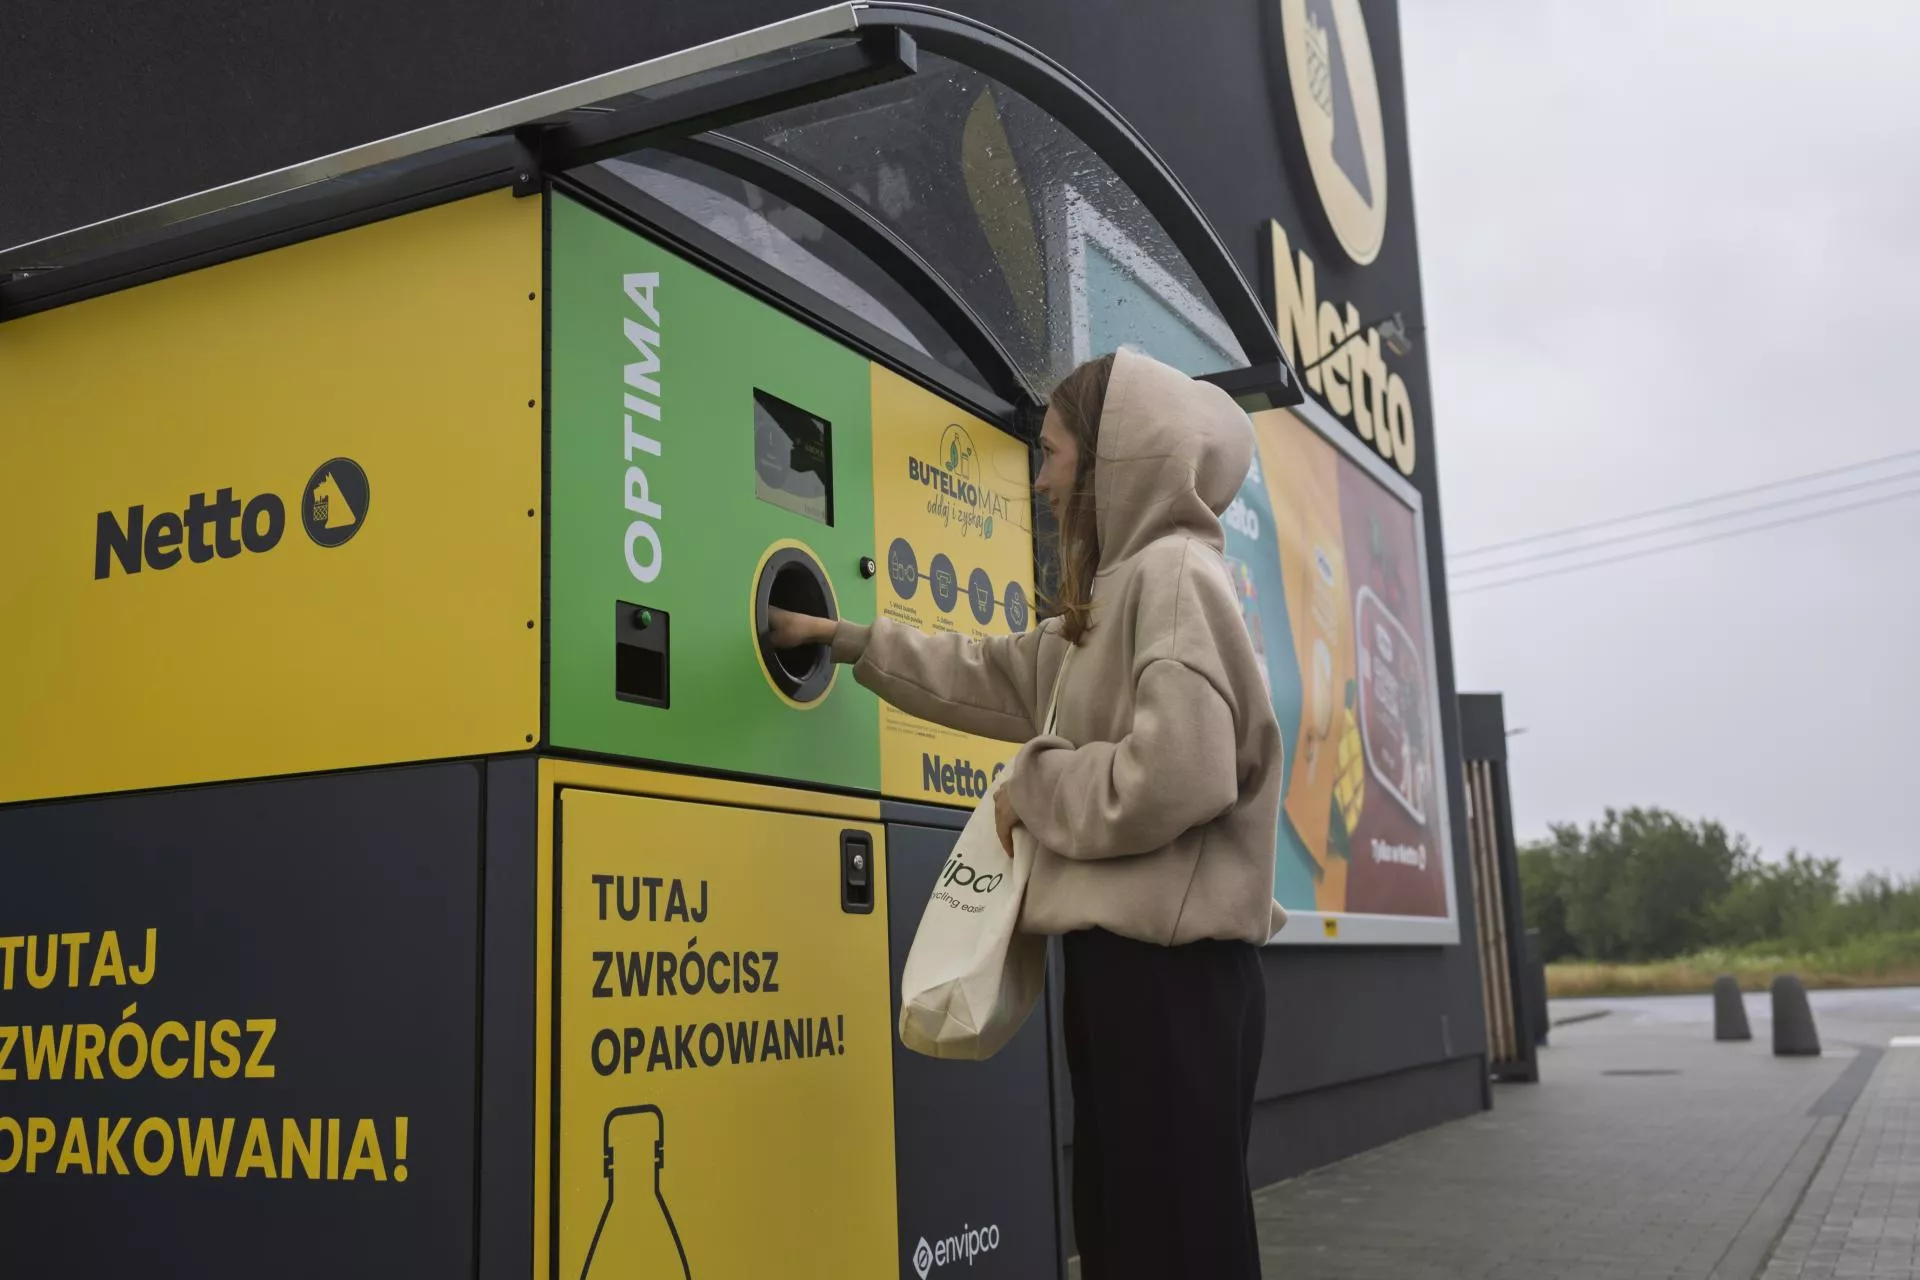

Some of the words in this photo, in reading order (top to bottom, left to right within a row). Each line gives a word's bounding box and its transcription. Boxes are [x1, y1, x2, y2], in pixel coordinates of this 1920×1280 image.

[1271, 218, 1416, 476] Netto
[624, 272, 662, 583] OPTIMA
[909, 455, 1011, 521] BUTELKOMAT
[927, 494, 950, 528] oddaj
[958, 506, 984, 537] zyskaj
[94, 487, 286, 581] Netto
[922, 752, 988, 800] Netto
[592, 874, 708, 923] TUTAJ
[0, 928, 156, 990] TUTAJ
[592, 936, 779, 998] ZWRÓCISZ
[0, 1001, 277, 1080] ZWRÓCISZ
[591, 1014, 845, 1076] OPAKOWANIA!
[0, 1116, 408, 1182] OPAKOWANIA!
[935, 1223, 1000, 1266] envipco
